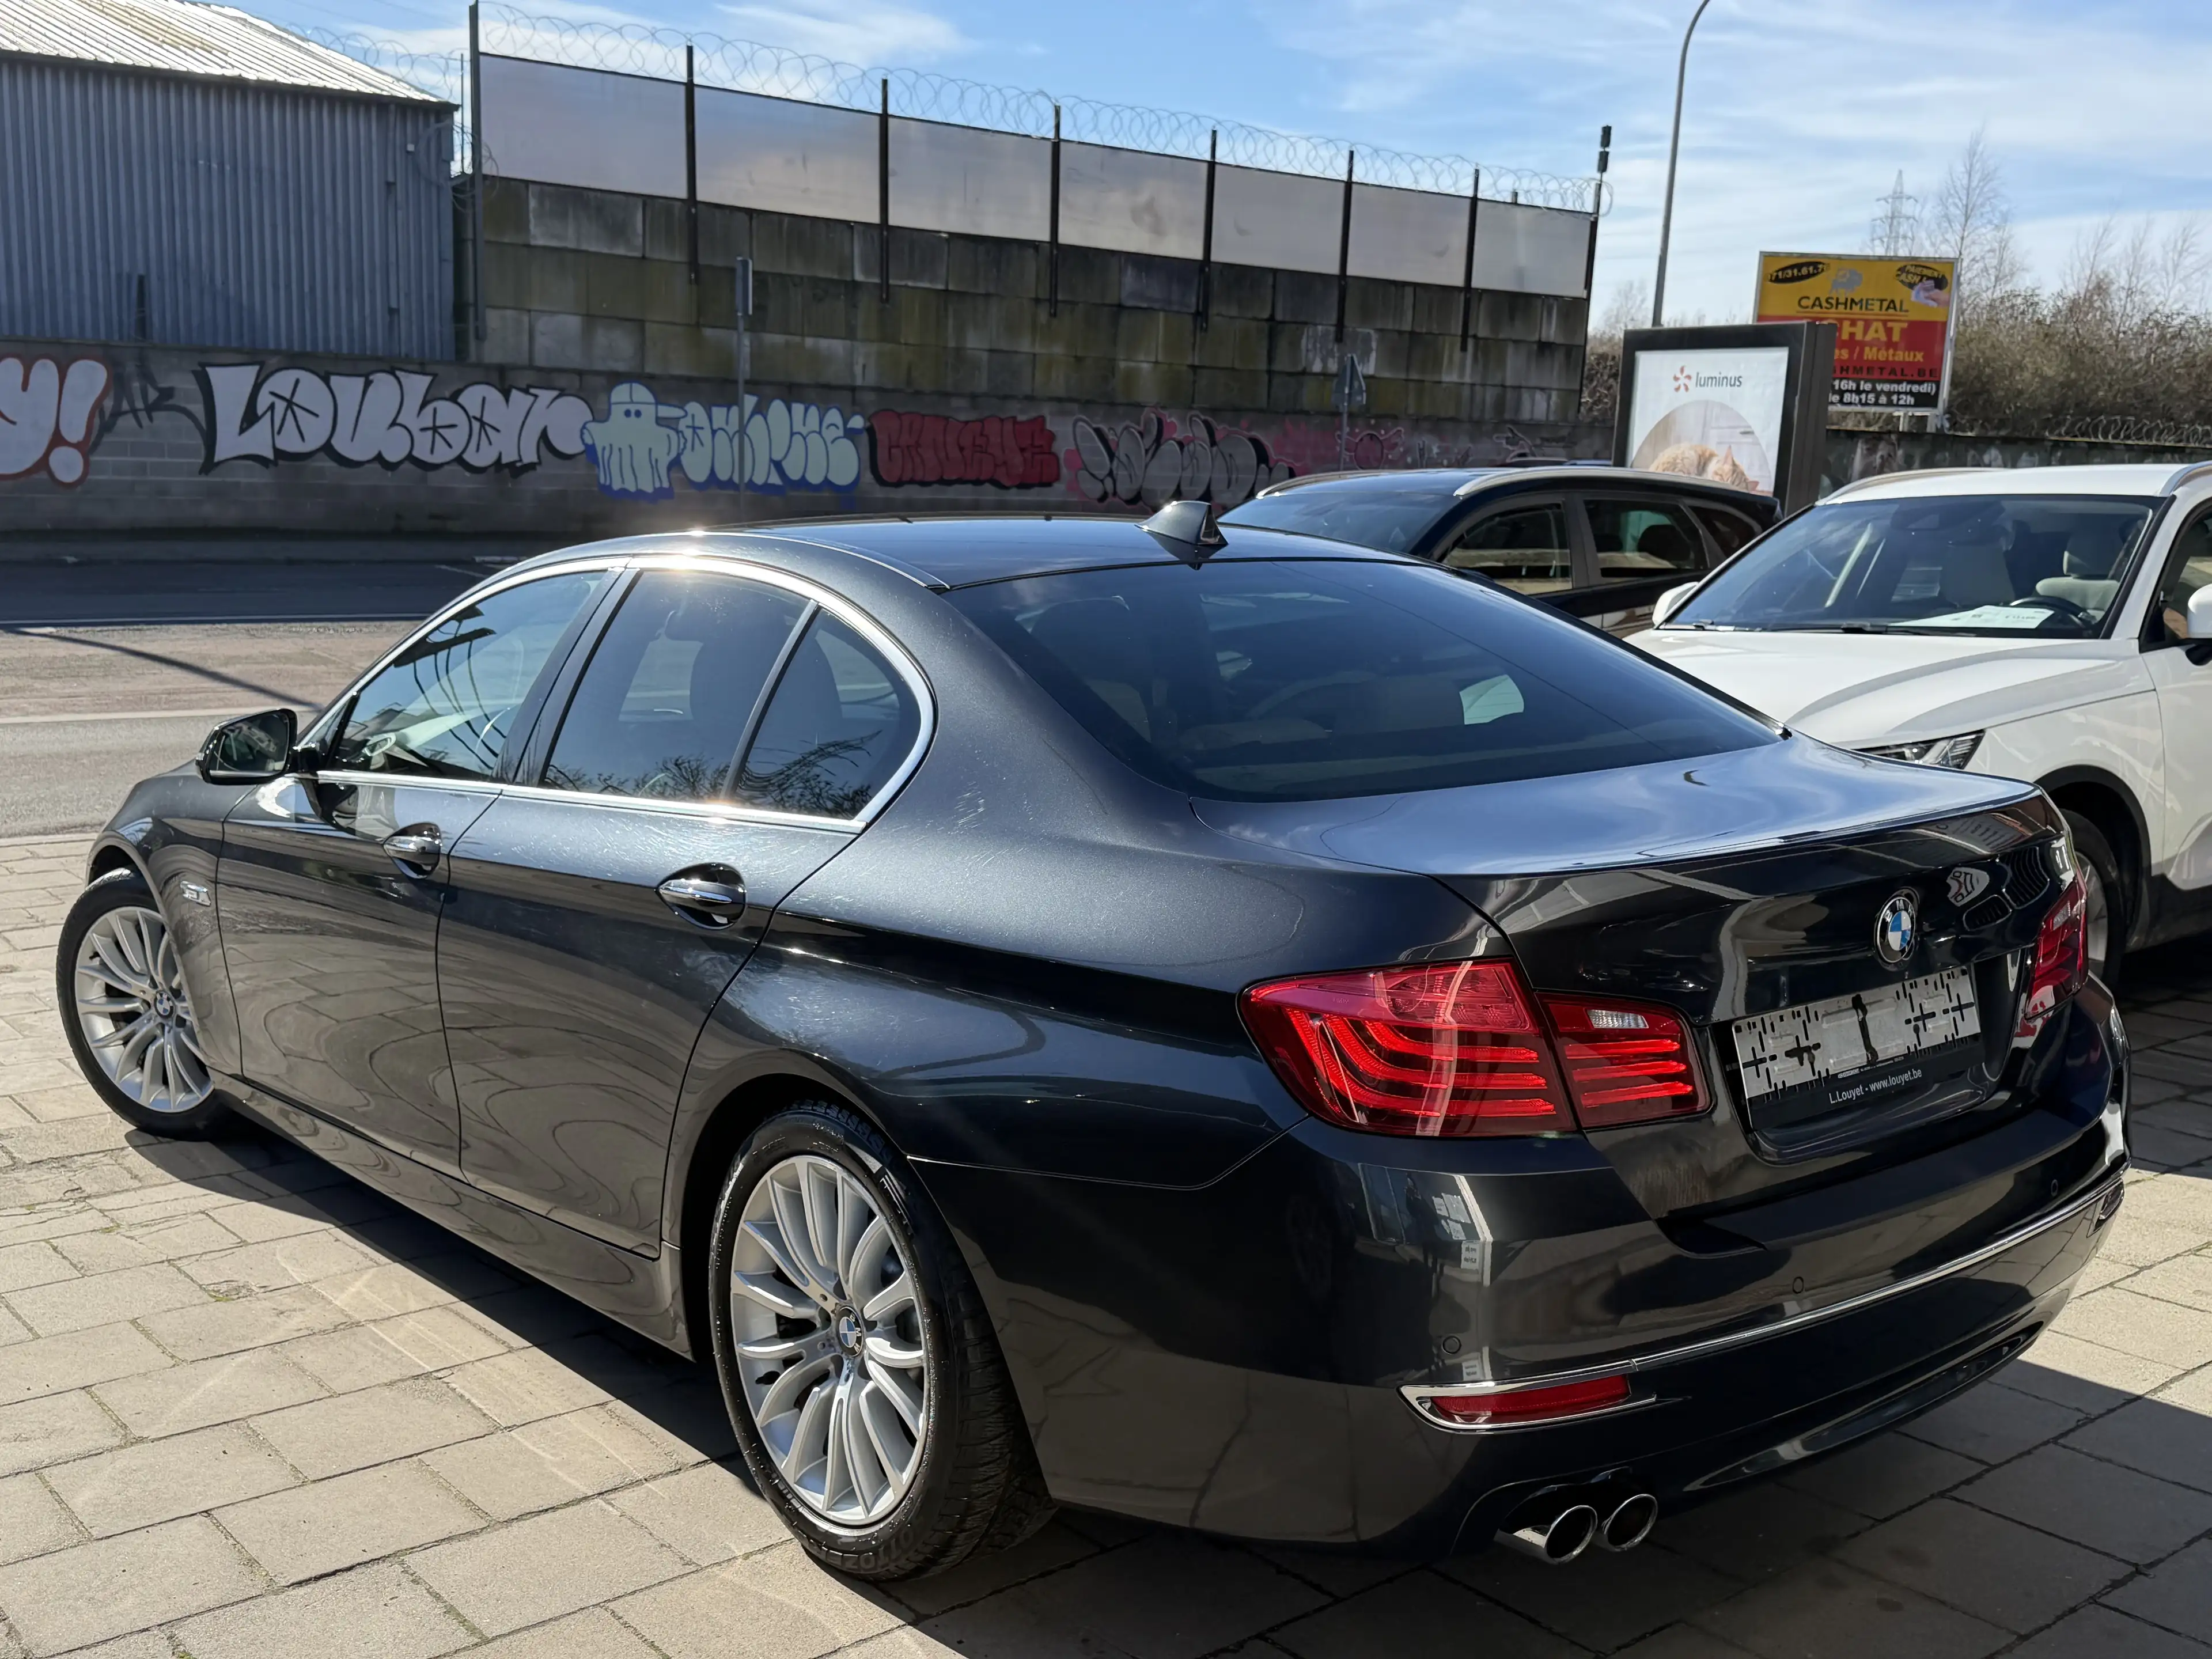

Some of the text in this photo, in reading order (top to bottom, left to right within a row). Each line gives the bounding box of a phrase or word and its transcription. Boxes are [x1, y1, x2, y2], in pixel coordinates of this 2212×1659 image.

[1798, 296, 1909, 312] CASHMETAL
[1695, 372, 1743, 388] luminus
[1860, 380, 1872, 391] le
[1876, 381, 1936, 395] vendredi)
[1891, 393, 1915, 405] 12h
[1828, 1084, 1864, 1104] L.Louyet
[1869, 1069, 1922, 1092] www.louyet.be
